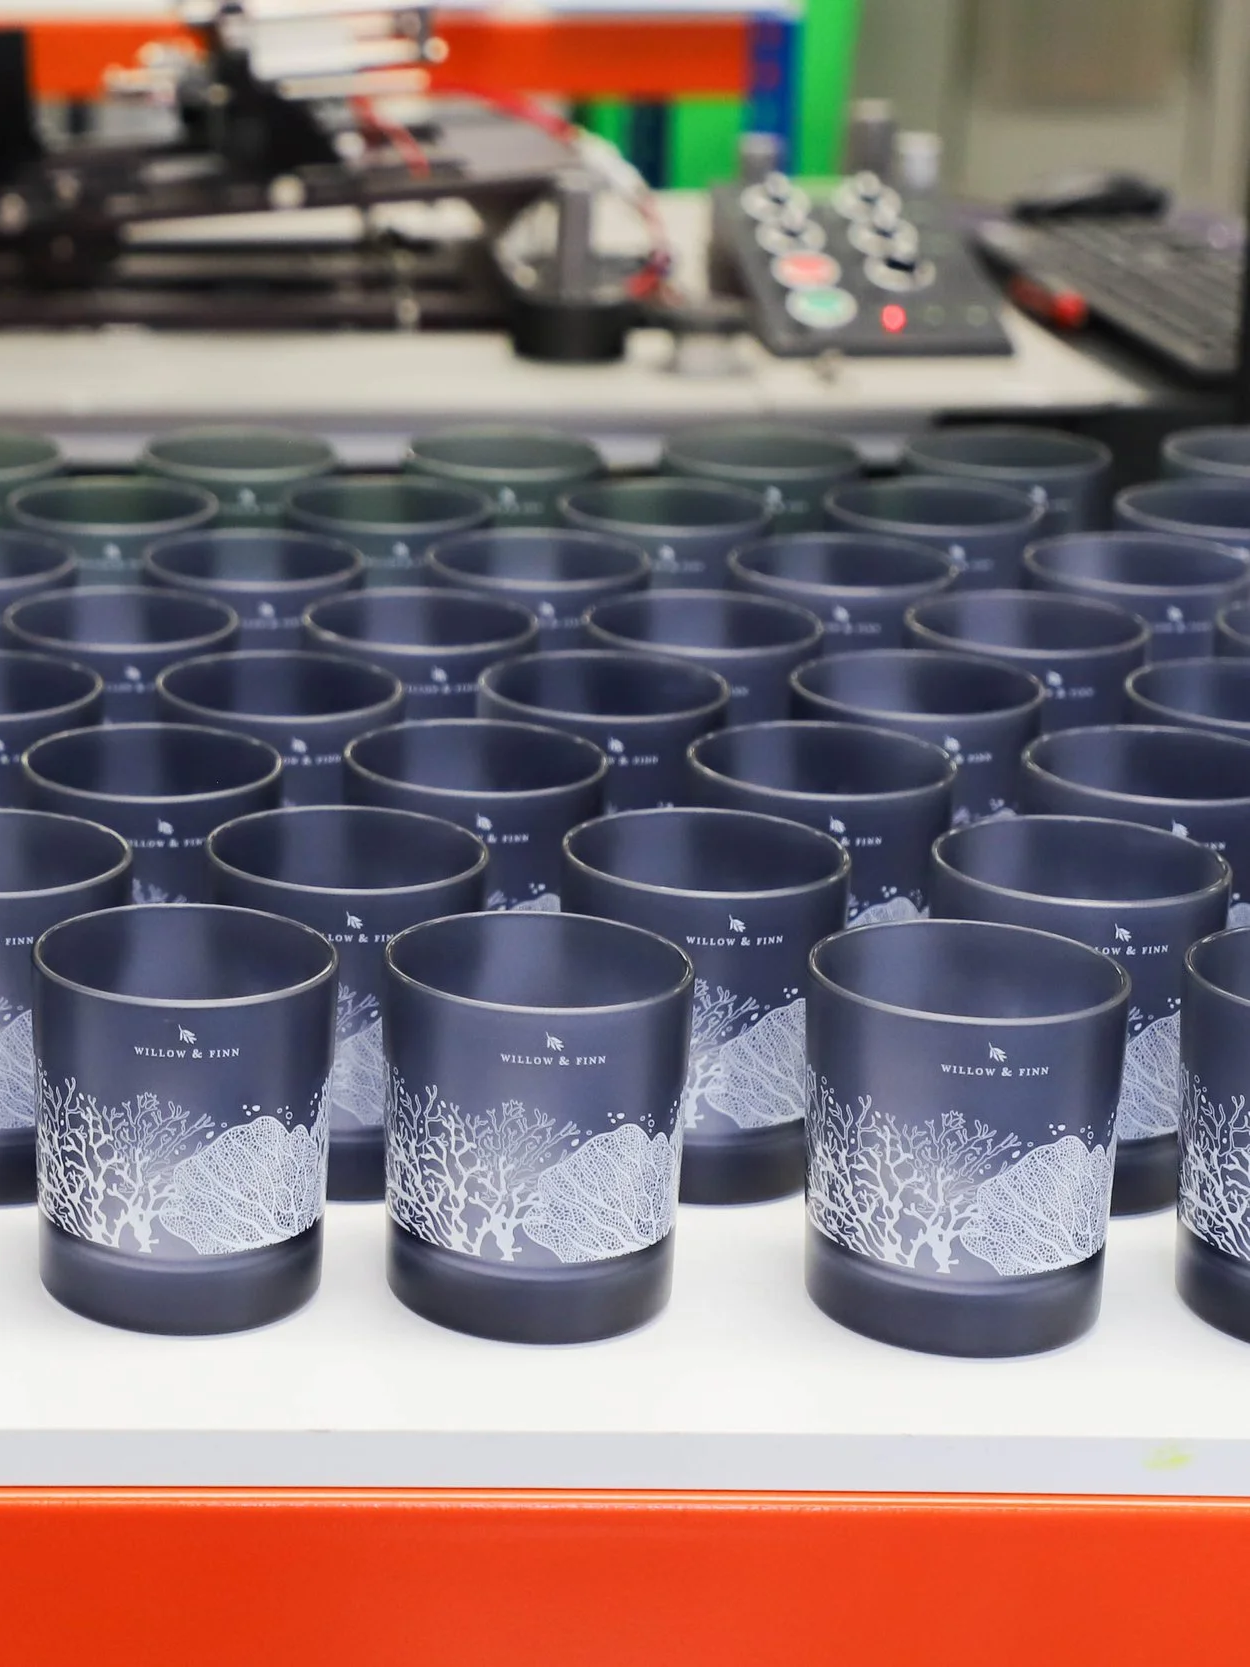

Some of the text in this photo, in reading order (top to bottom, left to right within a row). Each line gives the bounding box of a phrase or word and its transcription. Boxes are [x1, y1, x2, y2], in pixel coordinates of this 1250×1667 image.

[169, 838, 179, 848] &
[487, 833, 529, 844] & FINN
[4, 935, 34, 946] FINN
[358, 933, 368, 943] &
[686, 935, 783, 946] WILLOW & FINN
[1126, 945, 1136, 956] &
[1142, 944, 1169, 955] FINN
[134, 1046, 240, 1059] WILLOW & FINN
[500, 1053, 607, 1066] WILLOW & FINN
[941, 1064, 1049, 1077] WILLOW & FINN
